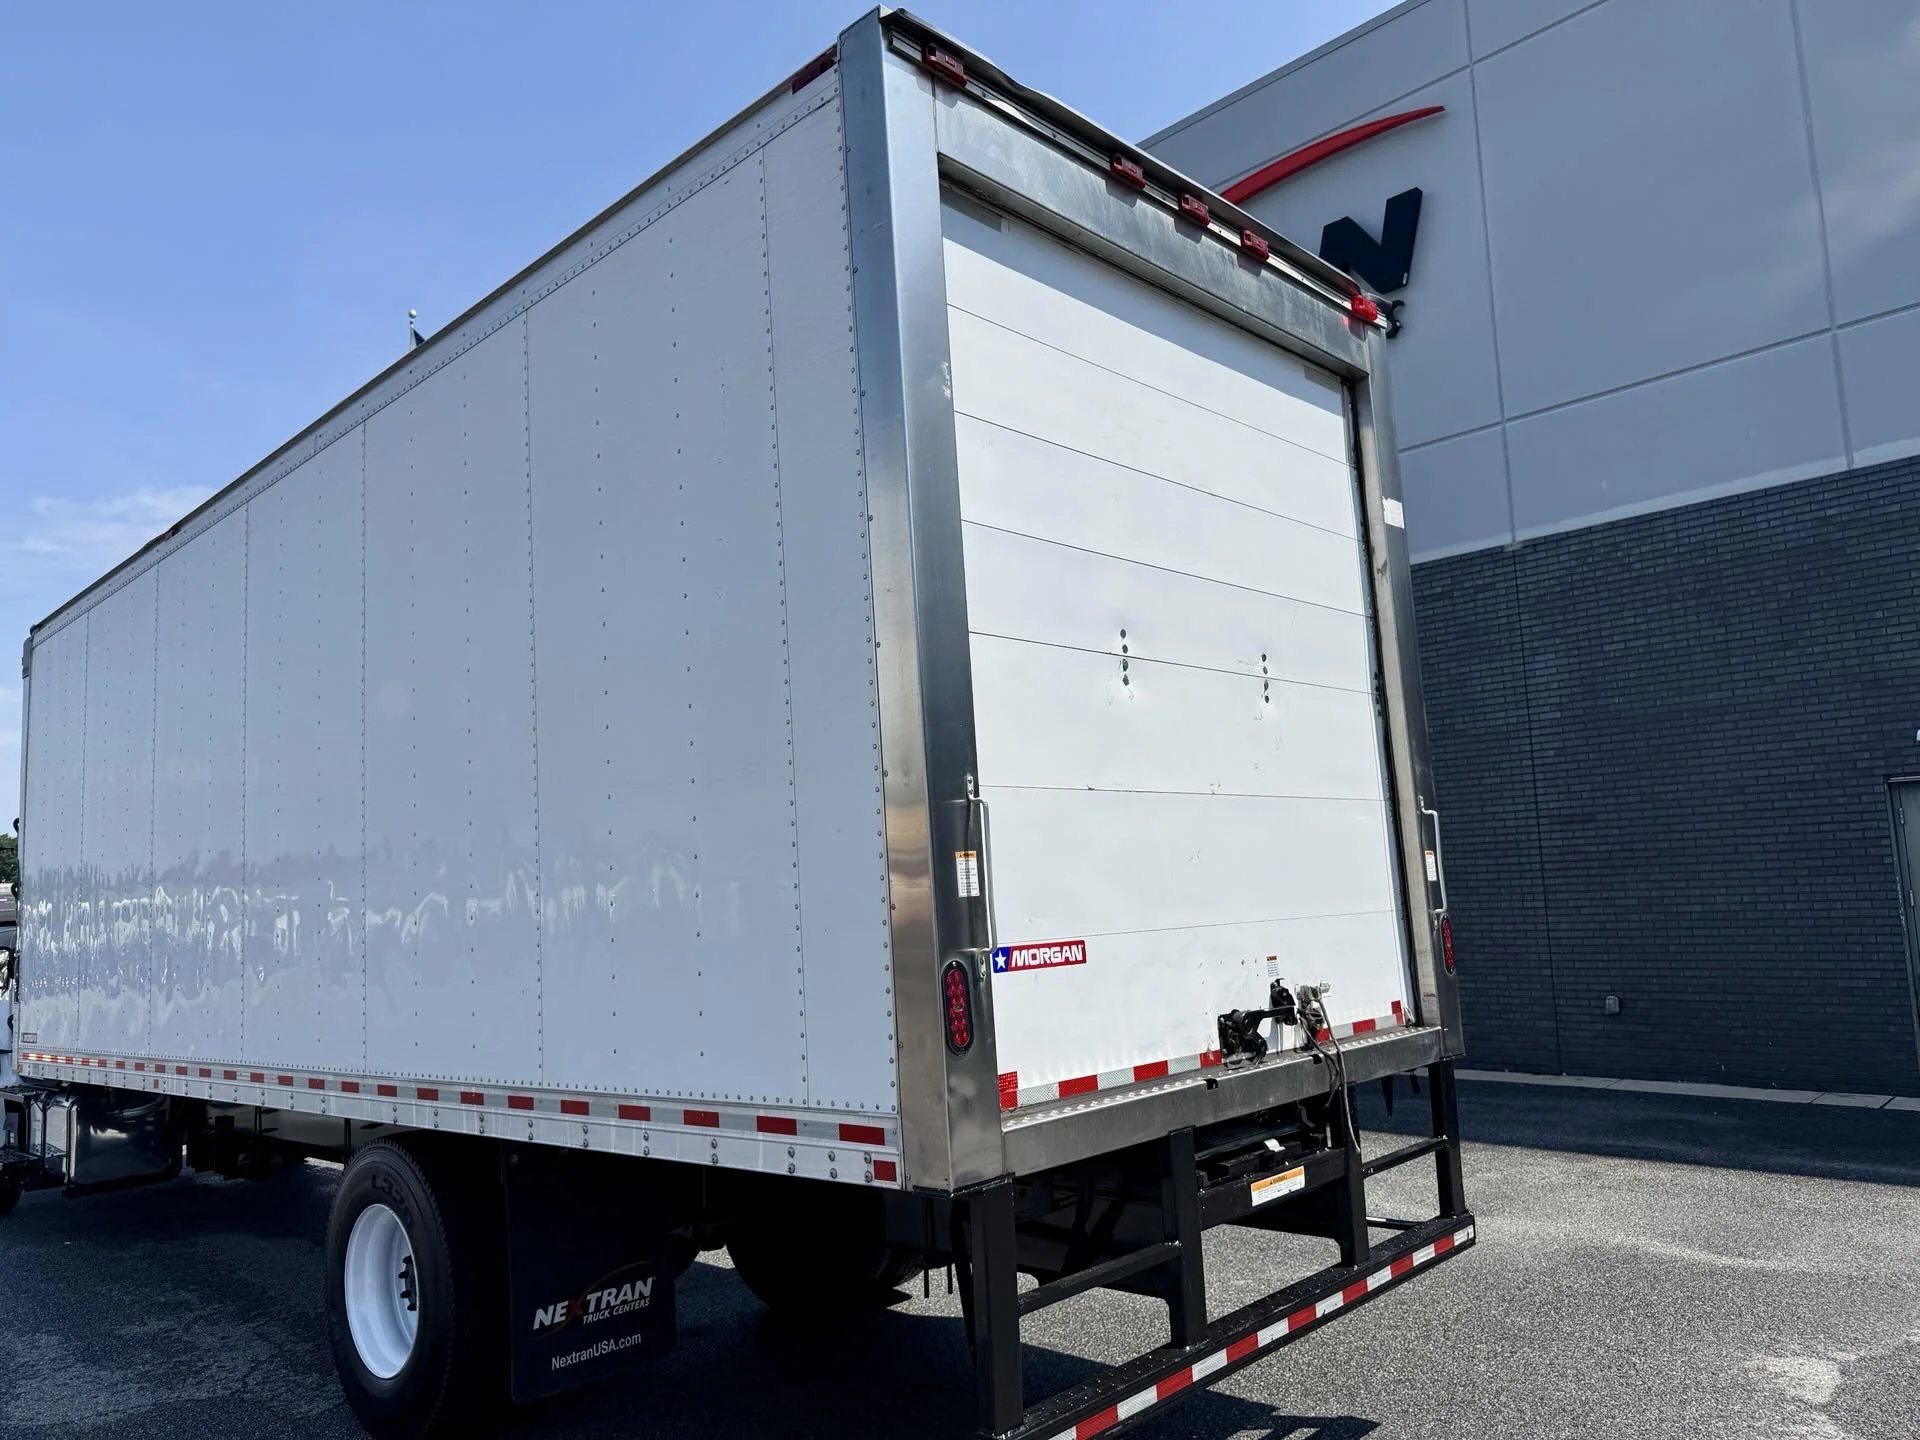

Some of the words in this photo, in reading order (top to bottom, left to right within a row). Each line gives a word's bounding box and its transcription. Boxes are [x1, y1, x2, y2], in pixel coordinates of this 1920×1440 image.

[1011, 944, 1083, 968] MORGAN
[532, 1276, 654, 1330] NEXTRAN
[582, 1308, 610, 1325] TRUCK
[613, 1298, 650, 1316] CENTERS
[551, 1333, 642, 1371] NextranUSA.com
